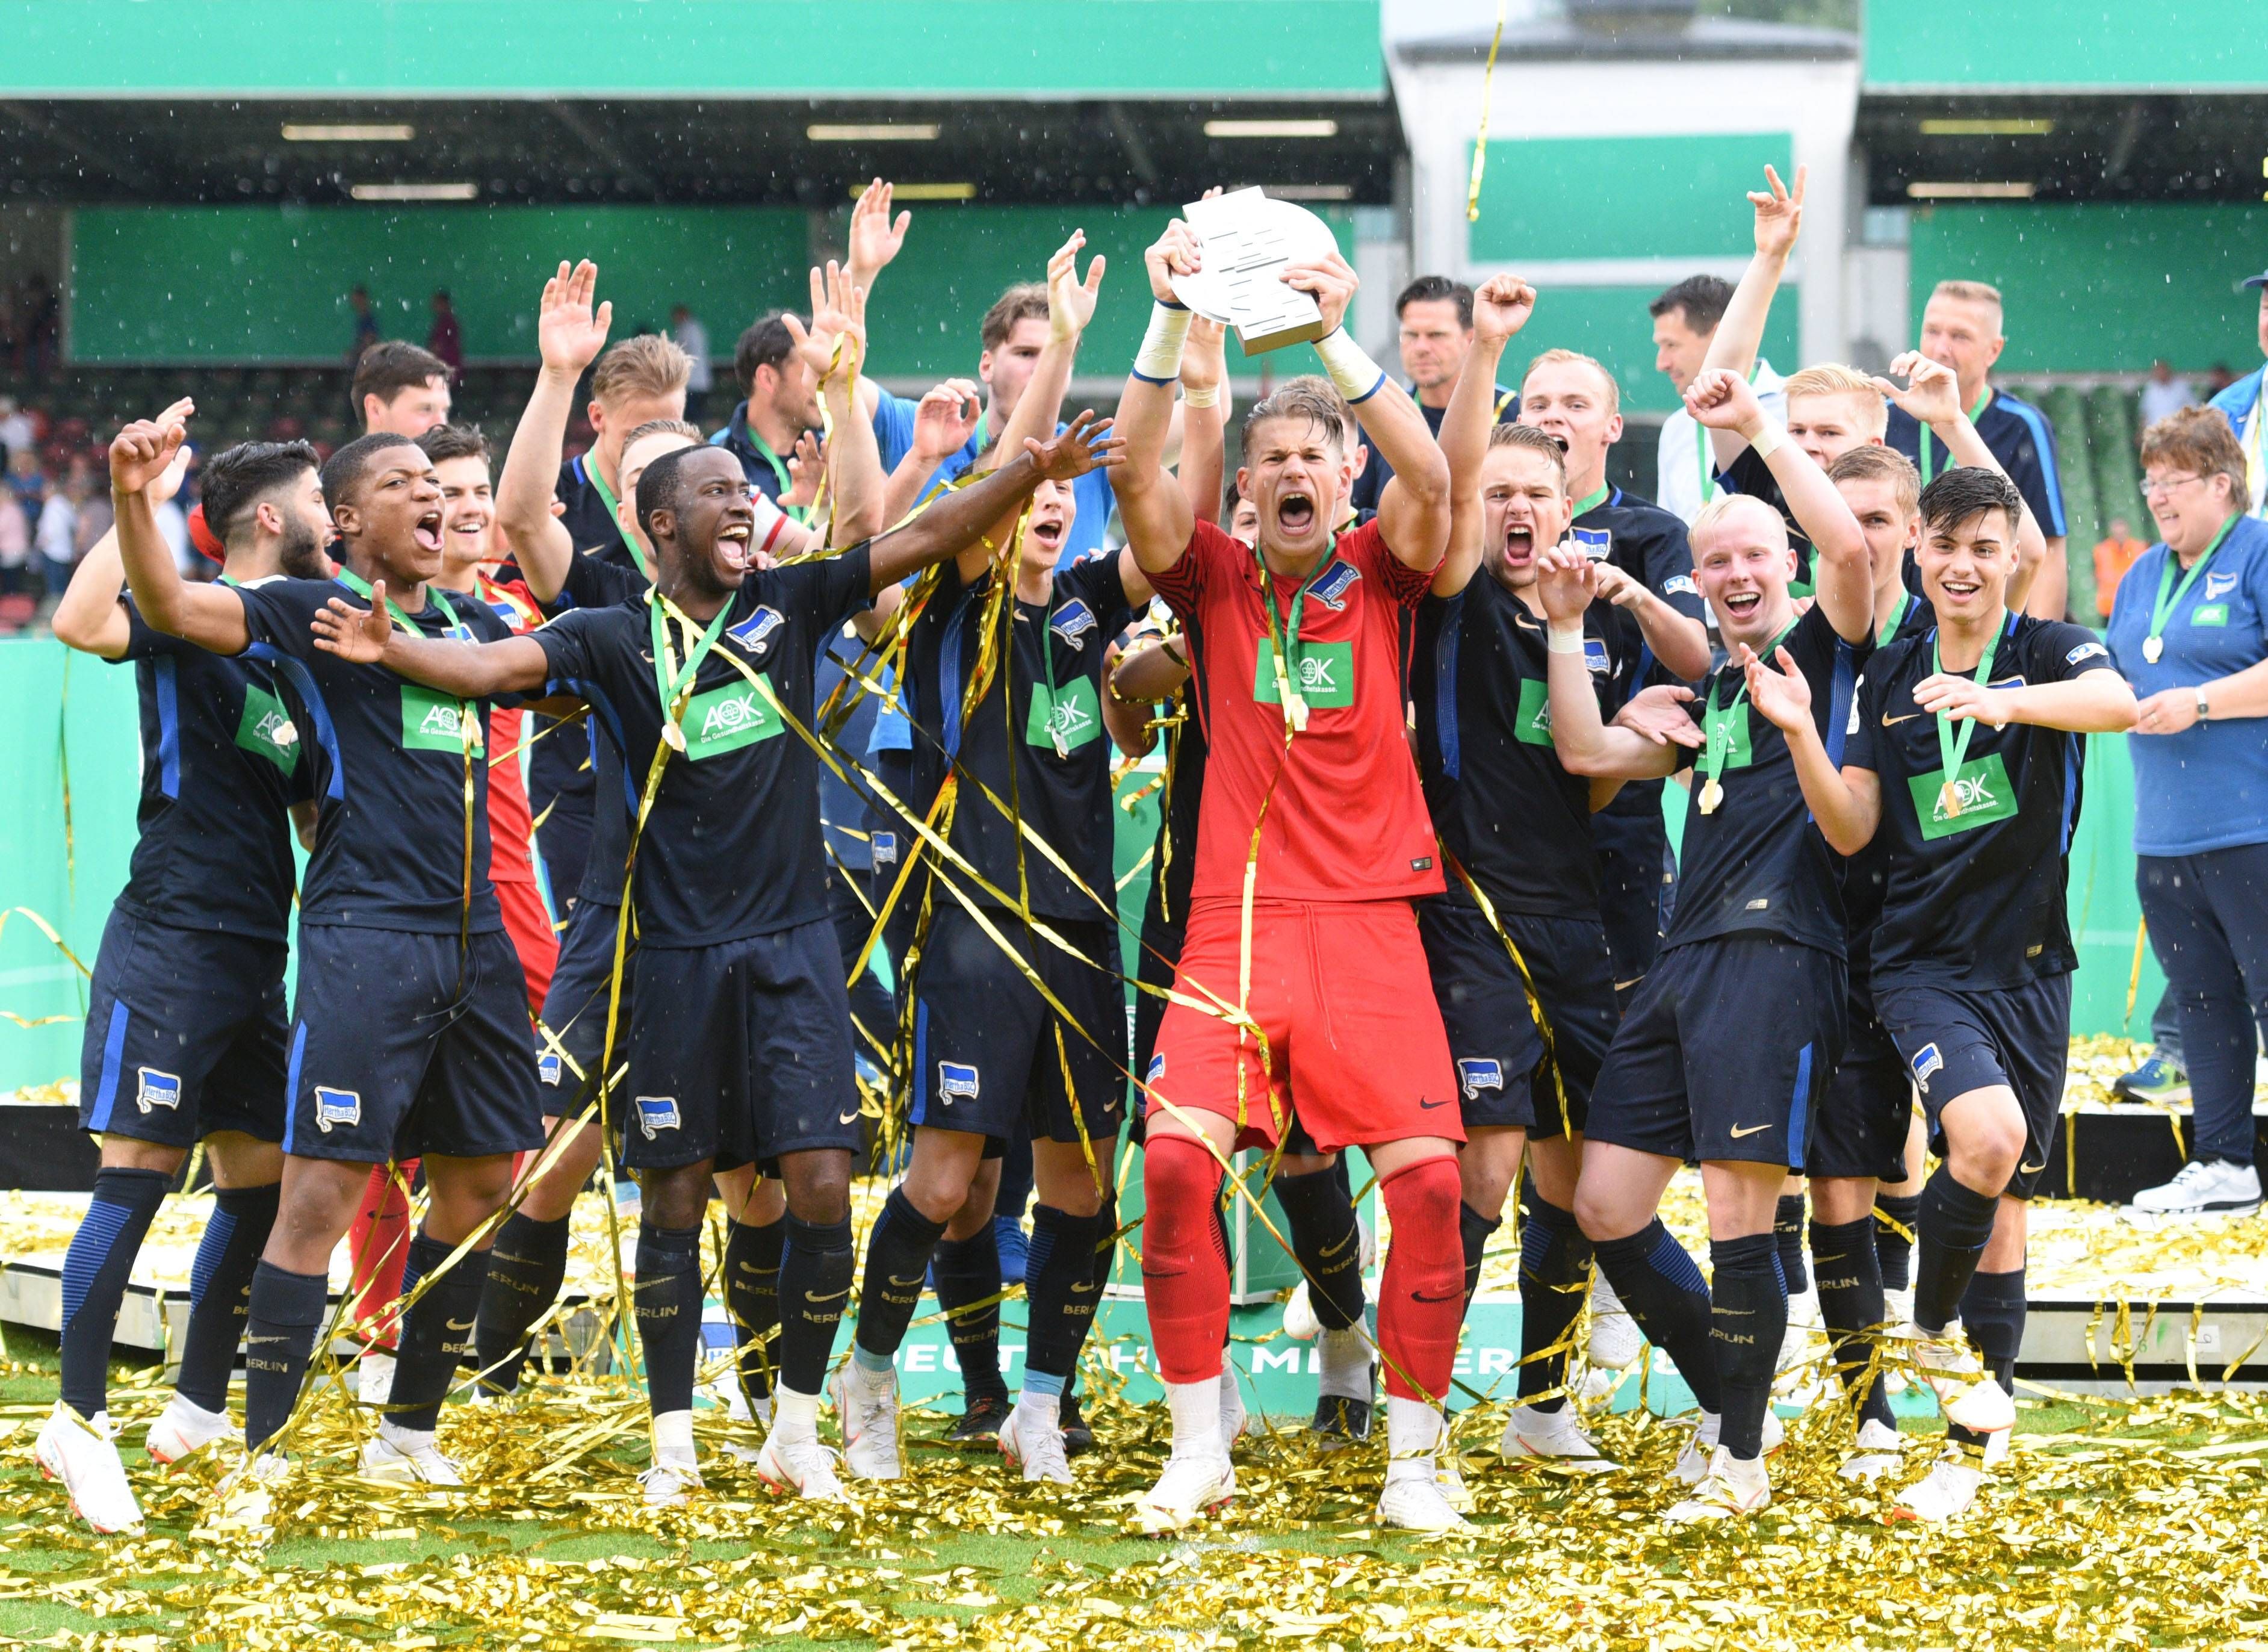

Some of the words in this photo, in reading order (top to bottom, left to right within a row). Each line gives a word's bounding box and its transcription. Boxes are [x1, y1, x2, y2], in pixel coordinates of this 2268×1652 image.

[1324, 578, 1345, 598] Hertha
[1341, 569, 1355, 582] BSC
[745, 625, 767, 641] Hertha
[763, 613, 777, 627] BSC
[1062, 620, 1083, 633] Hertha
[1079, 613, 1092, 624] BSC
[1299, 657, 1336, 685] OK
[255, 710, 285, 736] AO
[421, 704, 459, 731] AO
[701, 691, 763, 736] AOK
[701, 735, 712, 744] Die
[1933, 814, 1943, 822] Die
[146, 1086, 166, 1100] Hertha
[166, 1090, 176, 1102] BSC
[946, 1080, 964, 1091] Hertha
[964, 1082, 975, 1092] BSC
[324, 1105, 344, 1117] Hertha
[344, 1108, 355, 1118] BSC
[645, 1114, 665, 1124] Hertha
[663, 1113, 675, 1122] BSC
